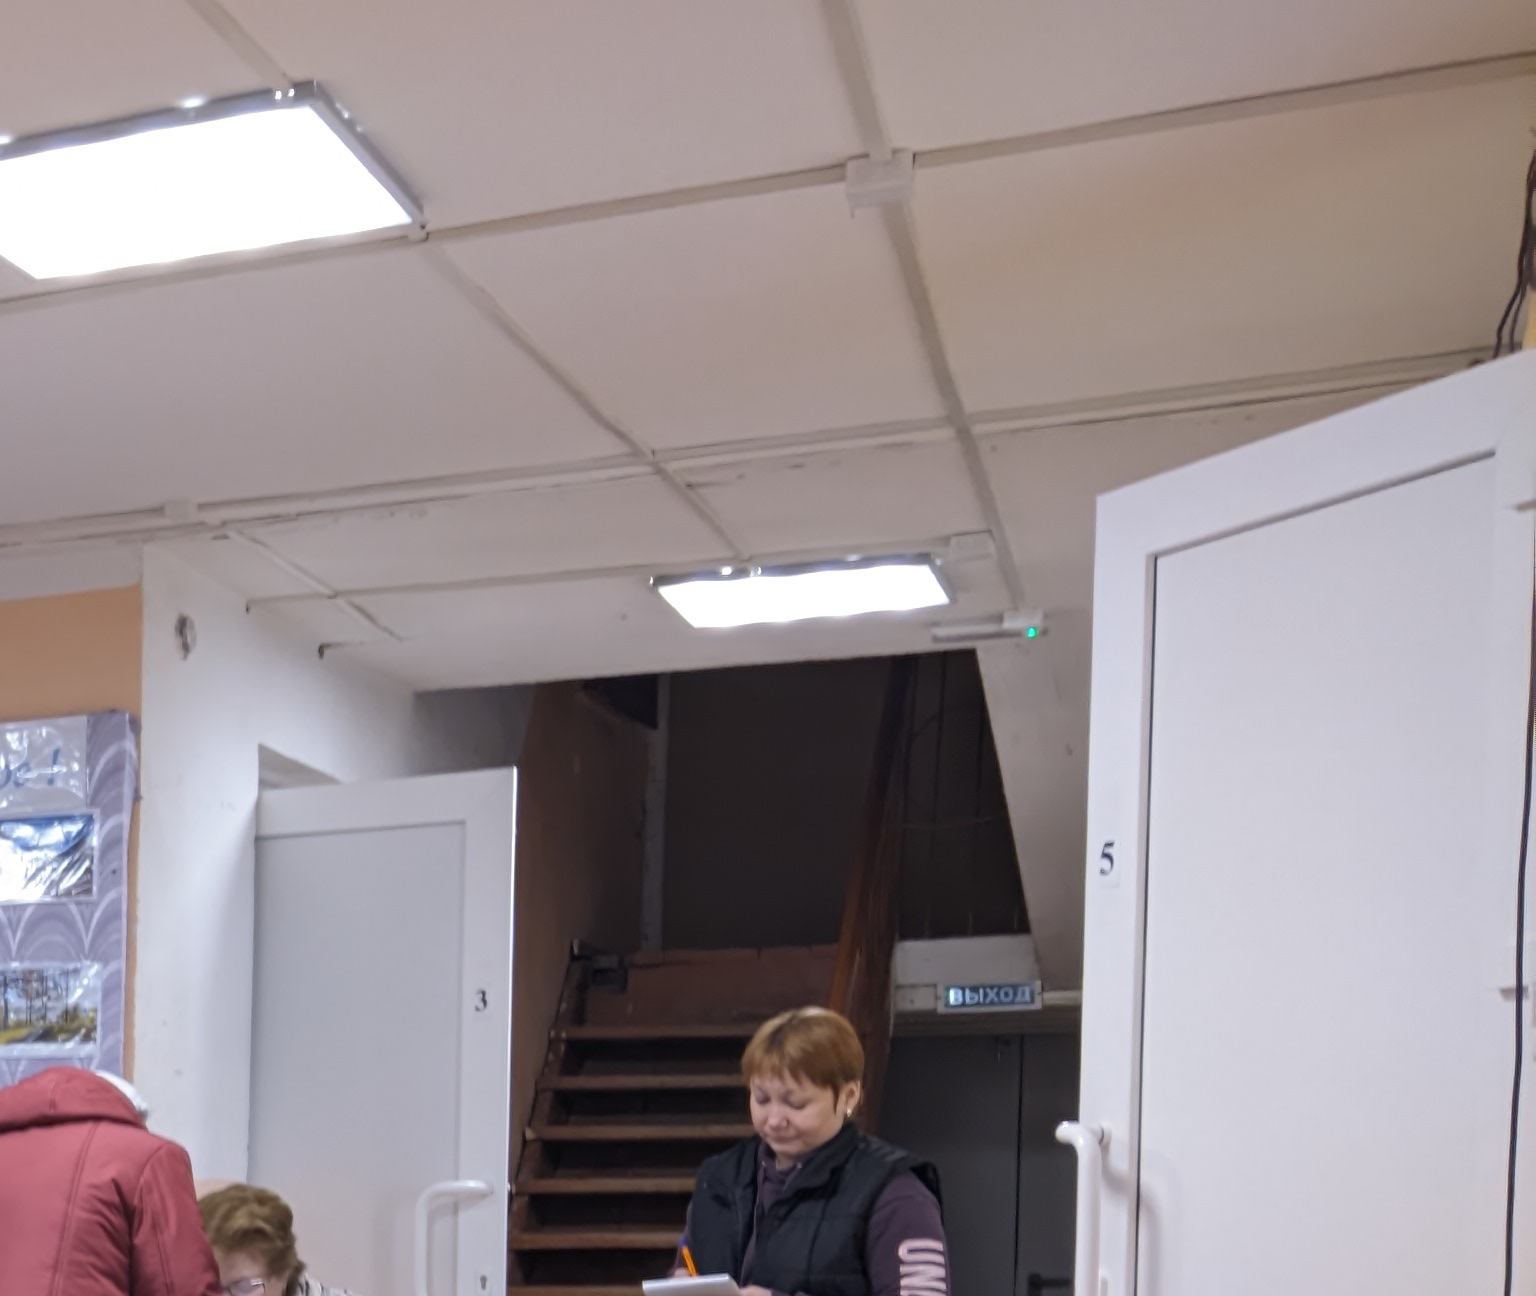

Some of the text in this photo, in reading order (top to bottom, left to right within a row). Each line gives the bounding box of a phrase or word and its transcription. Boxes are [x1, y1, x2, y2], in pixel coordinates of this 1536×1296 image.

[1099, 840, 1115, 876] 5
[474, 988, 488, 1012] 3
[948, 985, 1032, 1006] ВЫХОД
